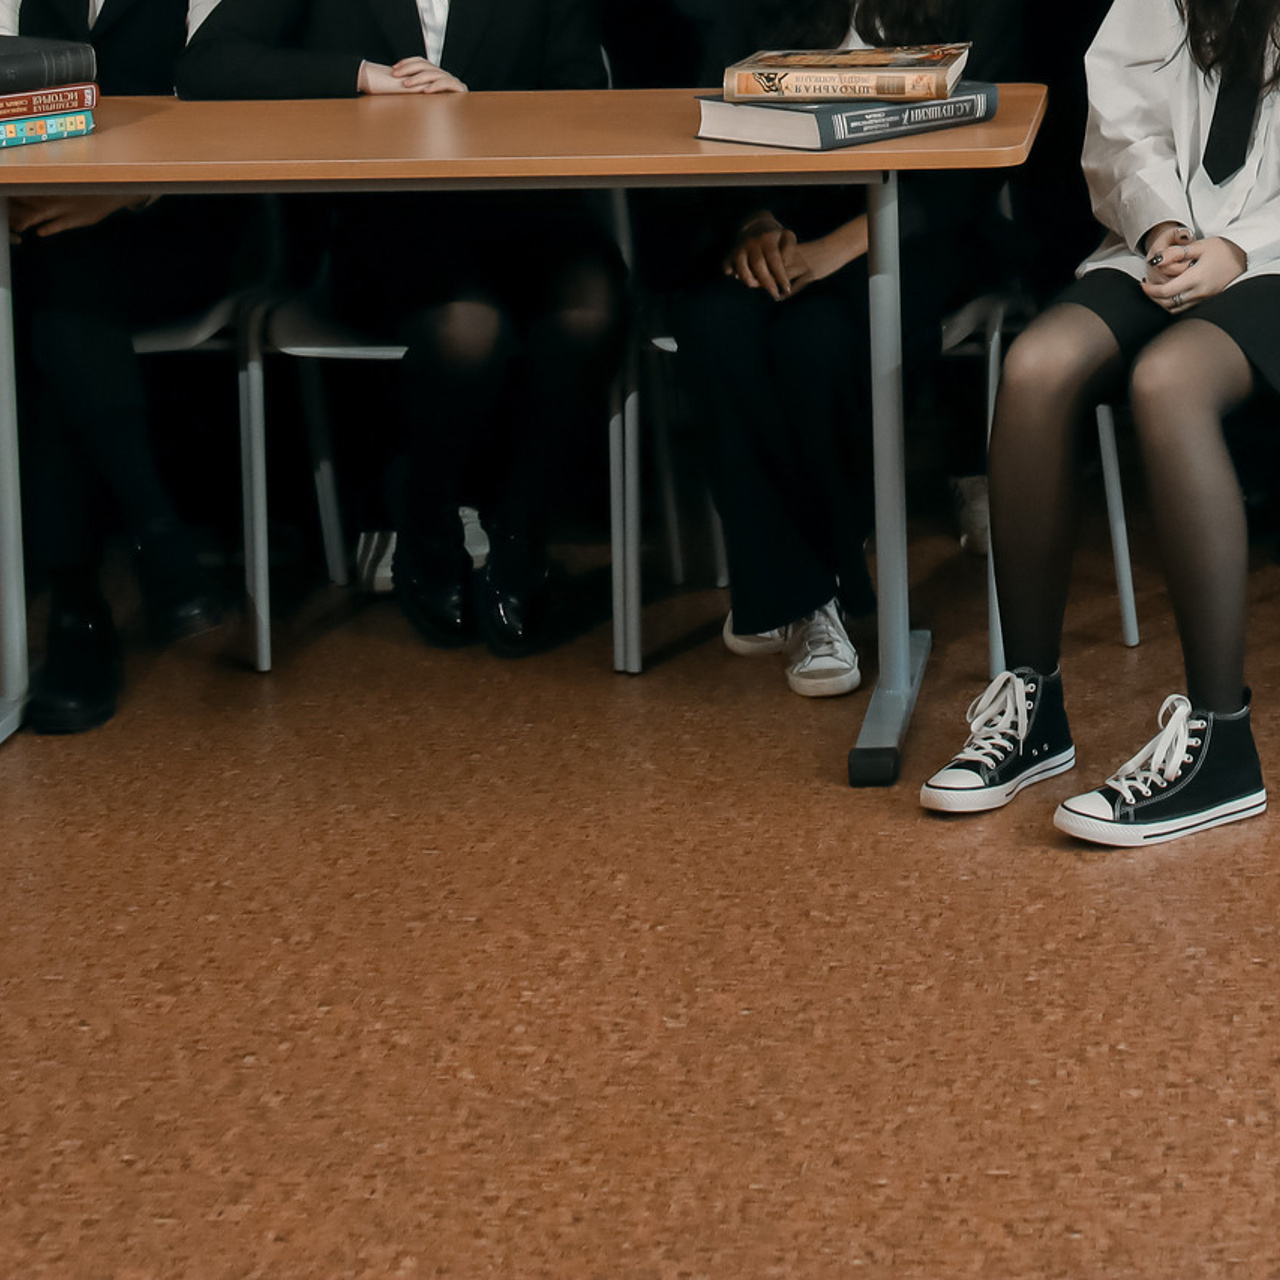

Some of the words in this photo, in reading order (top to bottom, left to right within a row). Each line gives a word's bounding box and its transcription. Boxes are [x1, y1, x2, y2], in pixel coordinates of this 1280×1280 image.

[795, 84, 870, 94] ШКОЛЬНАЯ
[33, 92, 78, 105] ИСТОРИЯ
[910, 104, 955, 122] ПУШКИН
